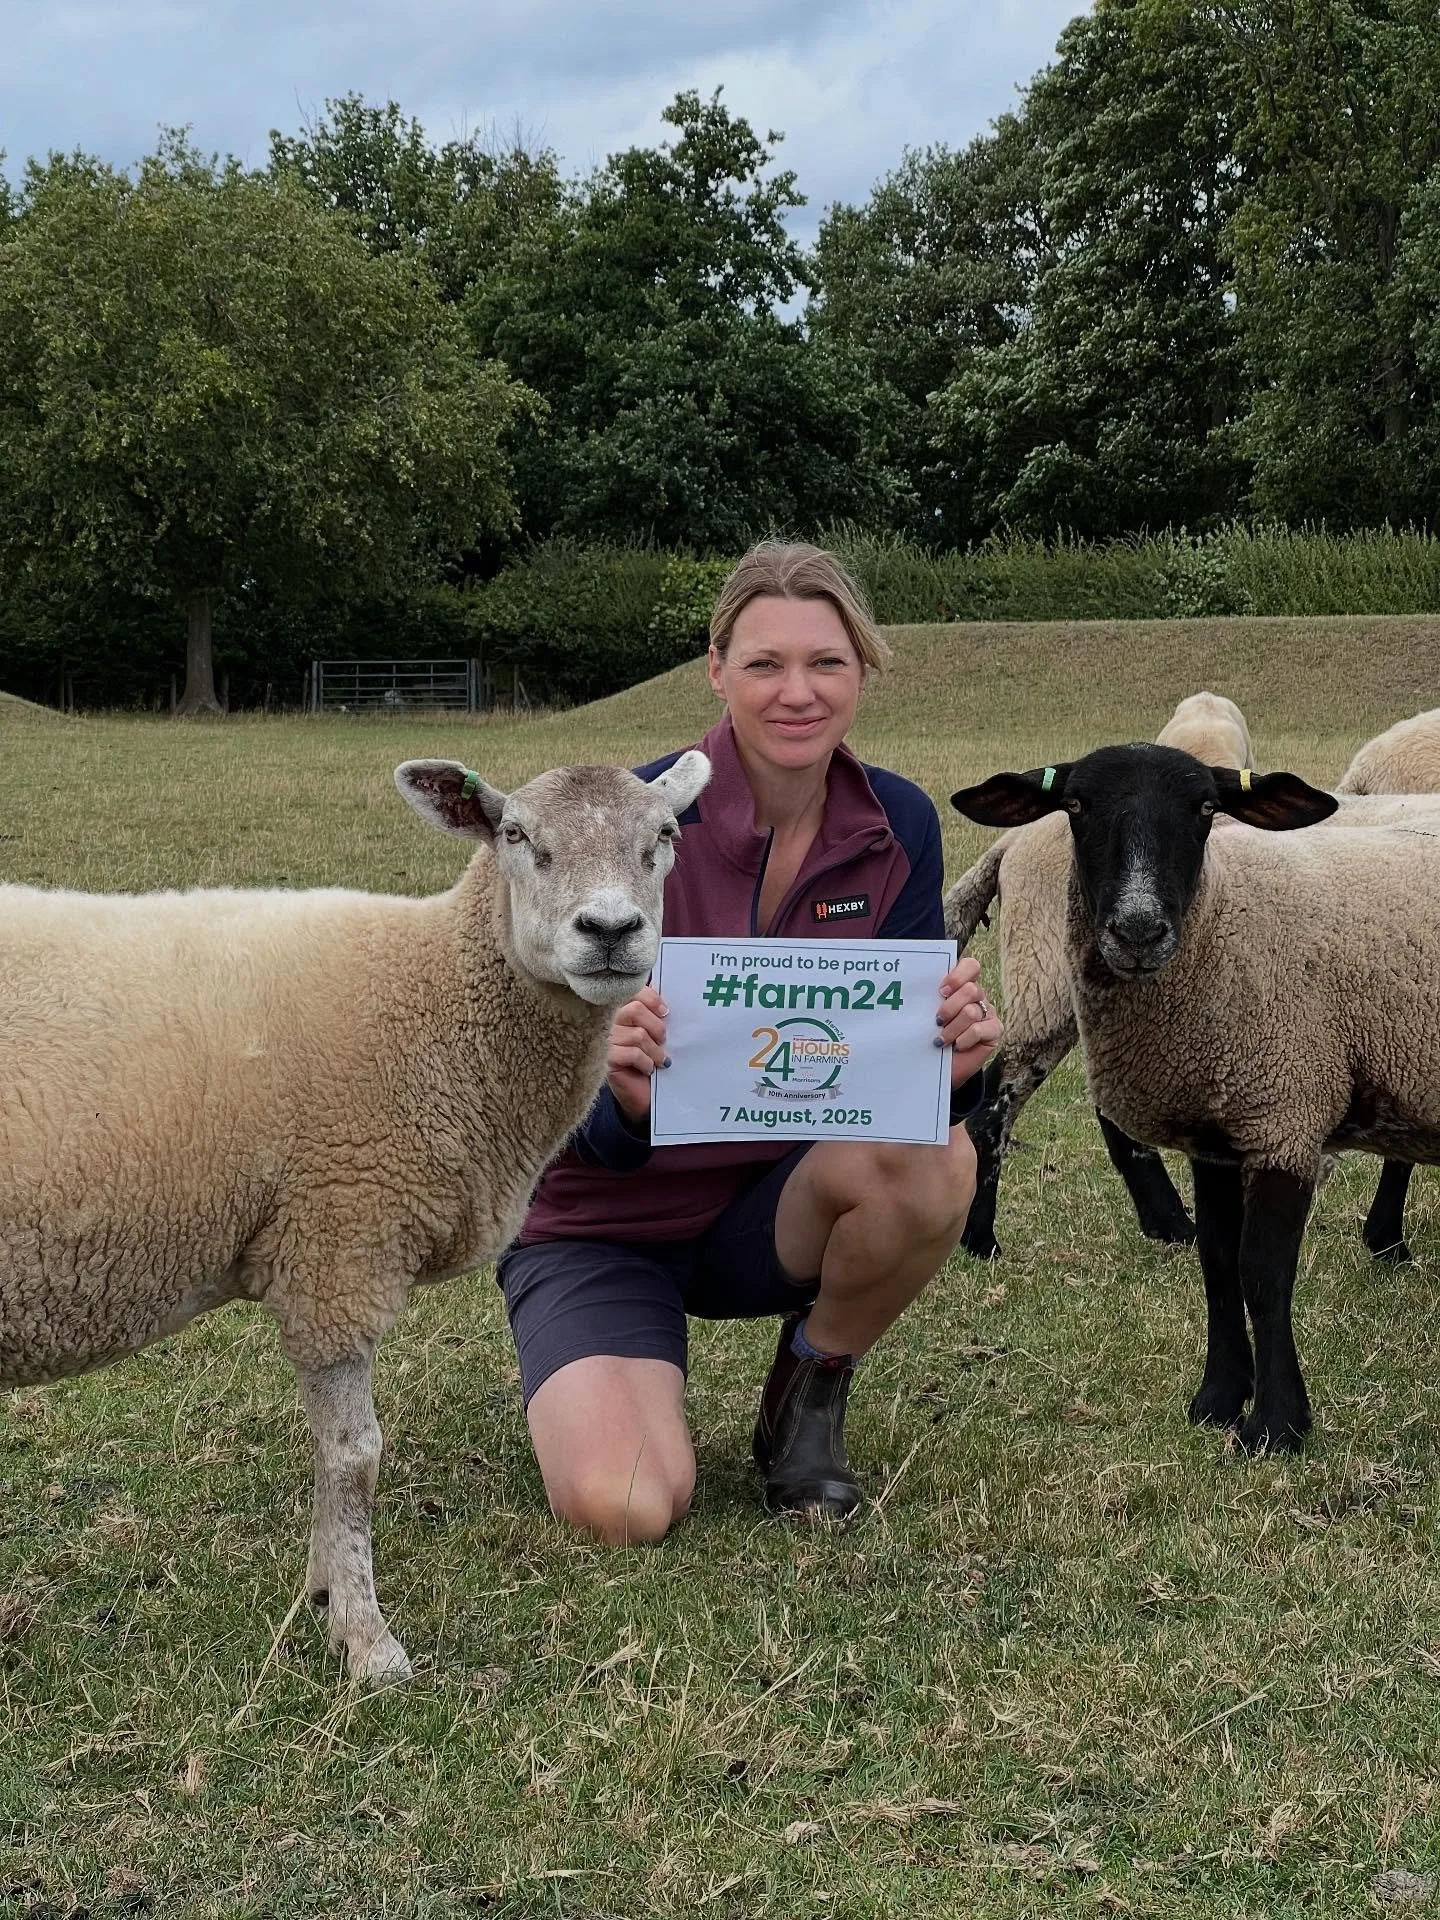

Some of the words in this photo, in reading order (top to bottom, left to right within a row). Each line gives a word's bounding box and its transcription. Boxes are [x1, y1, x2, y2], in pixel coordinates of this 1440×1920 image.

[828, 900, 865, 914] HEXBY
[742, 955, 792, 971] proud
[797, 957, 814, 969] to
[818, 957, 839, 970] be
[843, 958, 880, 974] part
[883, 958, 900, 972] of
[703, 973, 904, 1010] #farm24
[792, 1042, 850, 1056] HOURS
[791, 1055, 802, 1063] IN
[804, 1055, 849, 1065] FARMING
[768, 1090, 783, 1098] 10th
[784, 1092, 826, 1100] Anniversary
[720, 1107, 731, 1122] 7
[735, 1107, 817, 1127] August,
[822, 1109, 873, 1125] 2025
